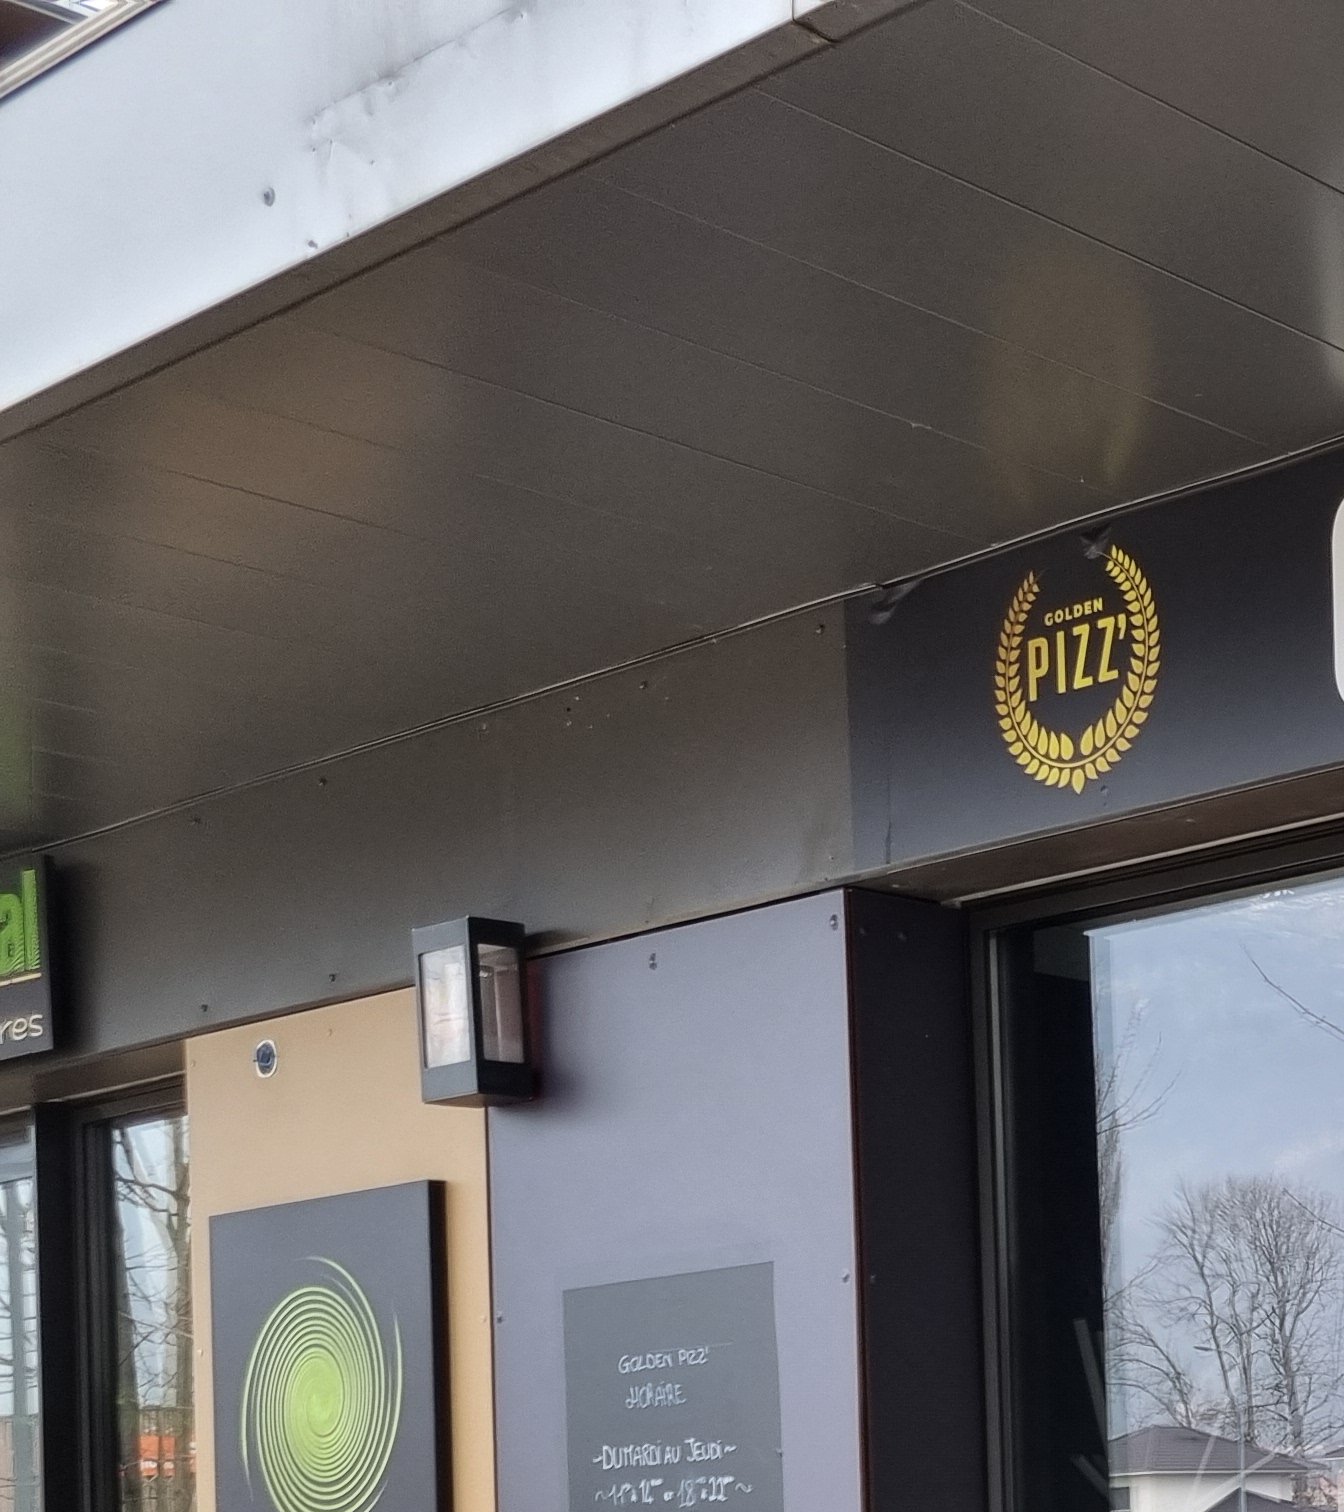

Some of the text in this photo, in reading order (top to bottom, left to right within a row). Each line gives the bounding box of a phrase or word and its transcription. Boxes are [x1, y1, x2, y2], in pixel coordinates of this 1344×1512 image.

[1044, 597, 1103, 627] GOLDEN
[1027, 613, 1126, 702] PIZZ'
[618, 1354, 673, 1374] GOLDEN
